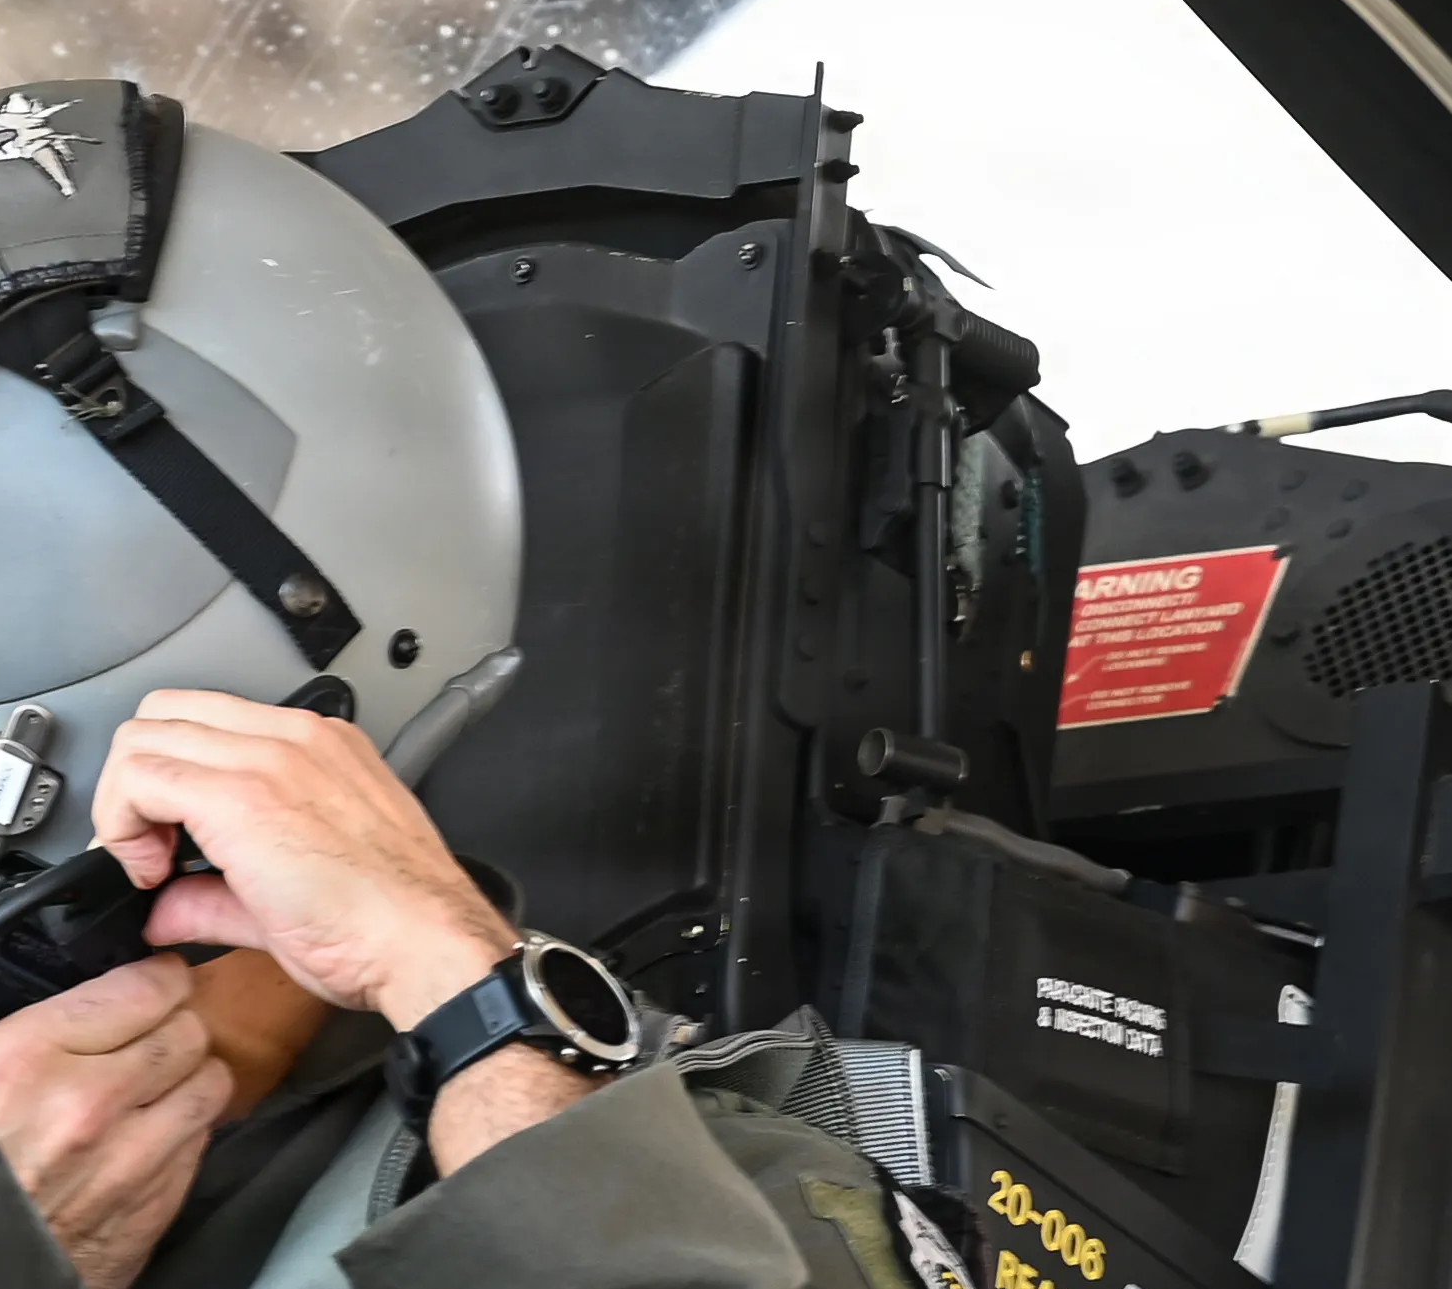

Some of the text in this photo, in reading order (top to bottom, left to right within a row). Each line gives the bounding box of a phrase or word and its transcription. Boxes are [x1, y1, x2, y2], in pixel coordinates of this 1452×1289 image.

[1074, 565, 1203, 601] ARNING
[1135, 620, 1226, 640] LOCATION
[987, 1169, 1107, 1281] 20-006
